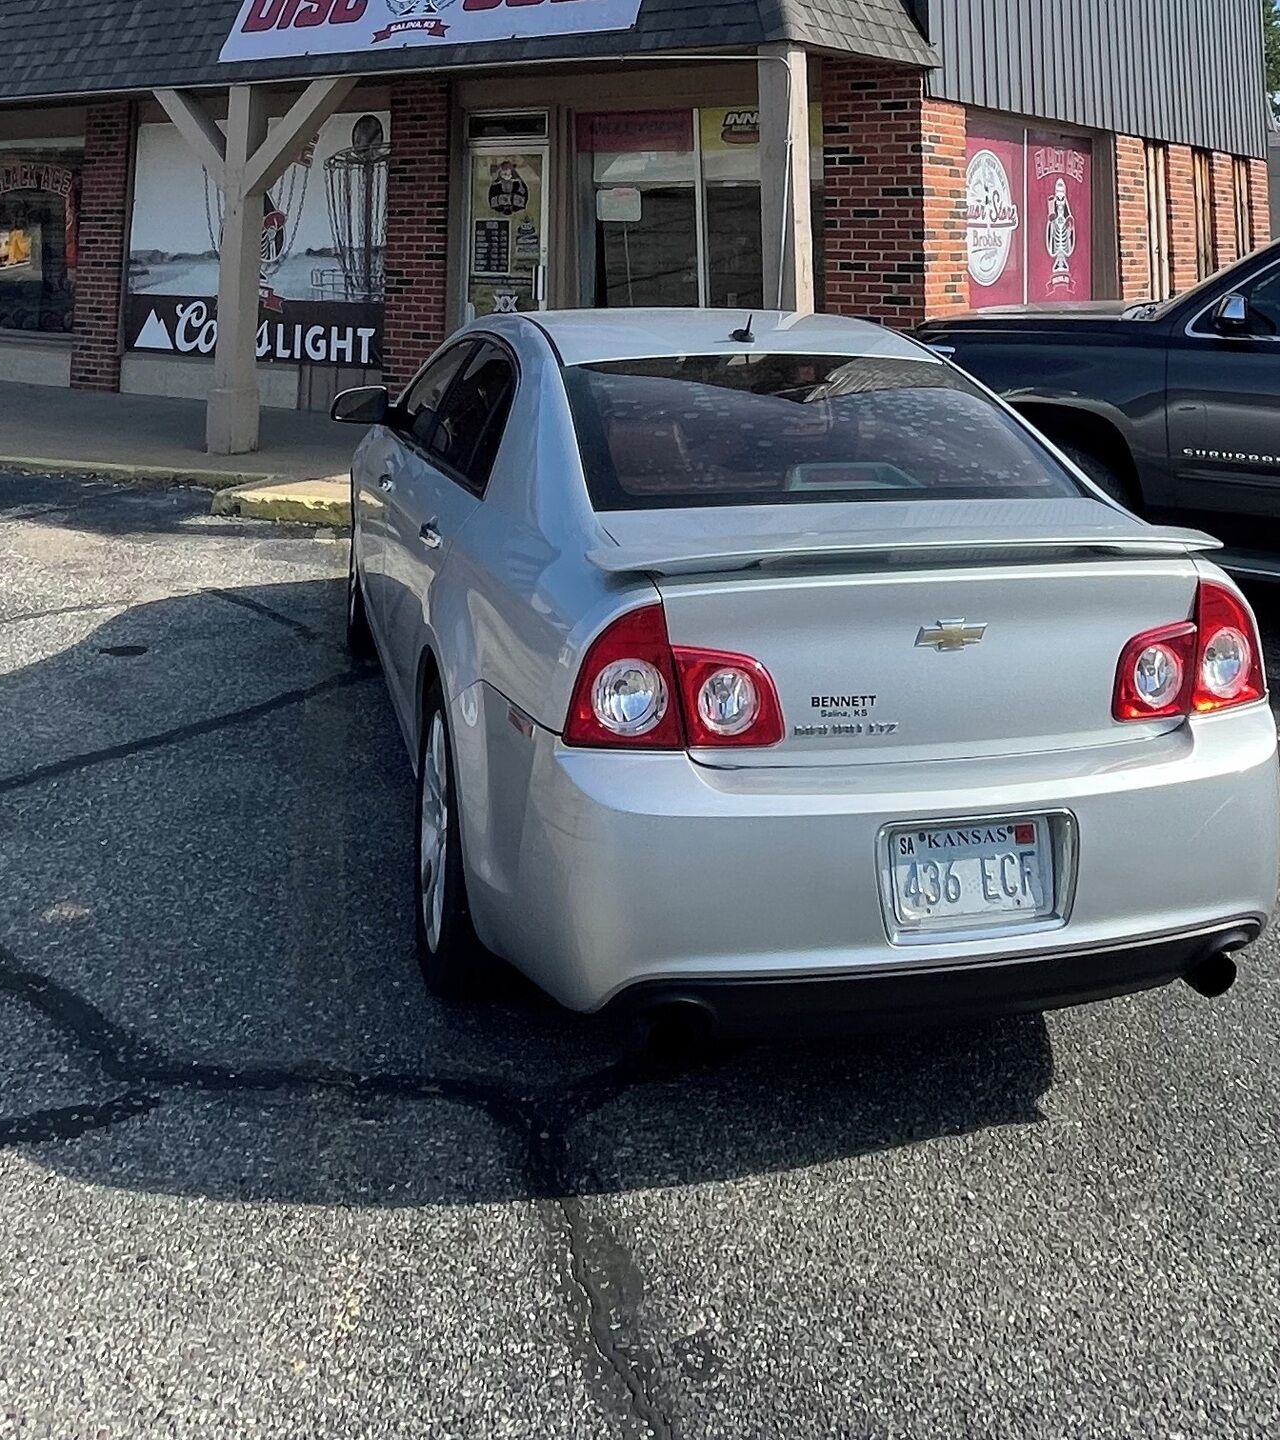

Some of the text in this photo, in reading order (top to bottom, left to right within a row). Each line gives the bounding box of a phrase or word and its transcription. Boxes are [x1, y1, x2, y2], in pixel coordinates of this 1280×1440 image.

[725, 111, 760, 125] INN
[40, 164, 73, 198] ACE
[175, 301, 376, 364] Cos LIGHT
[811, 695, 877, 708] BENNETT
[820, 709, 868, 718] Salina, KS
[900, 828, 1008, 855] SA KANSAS
